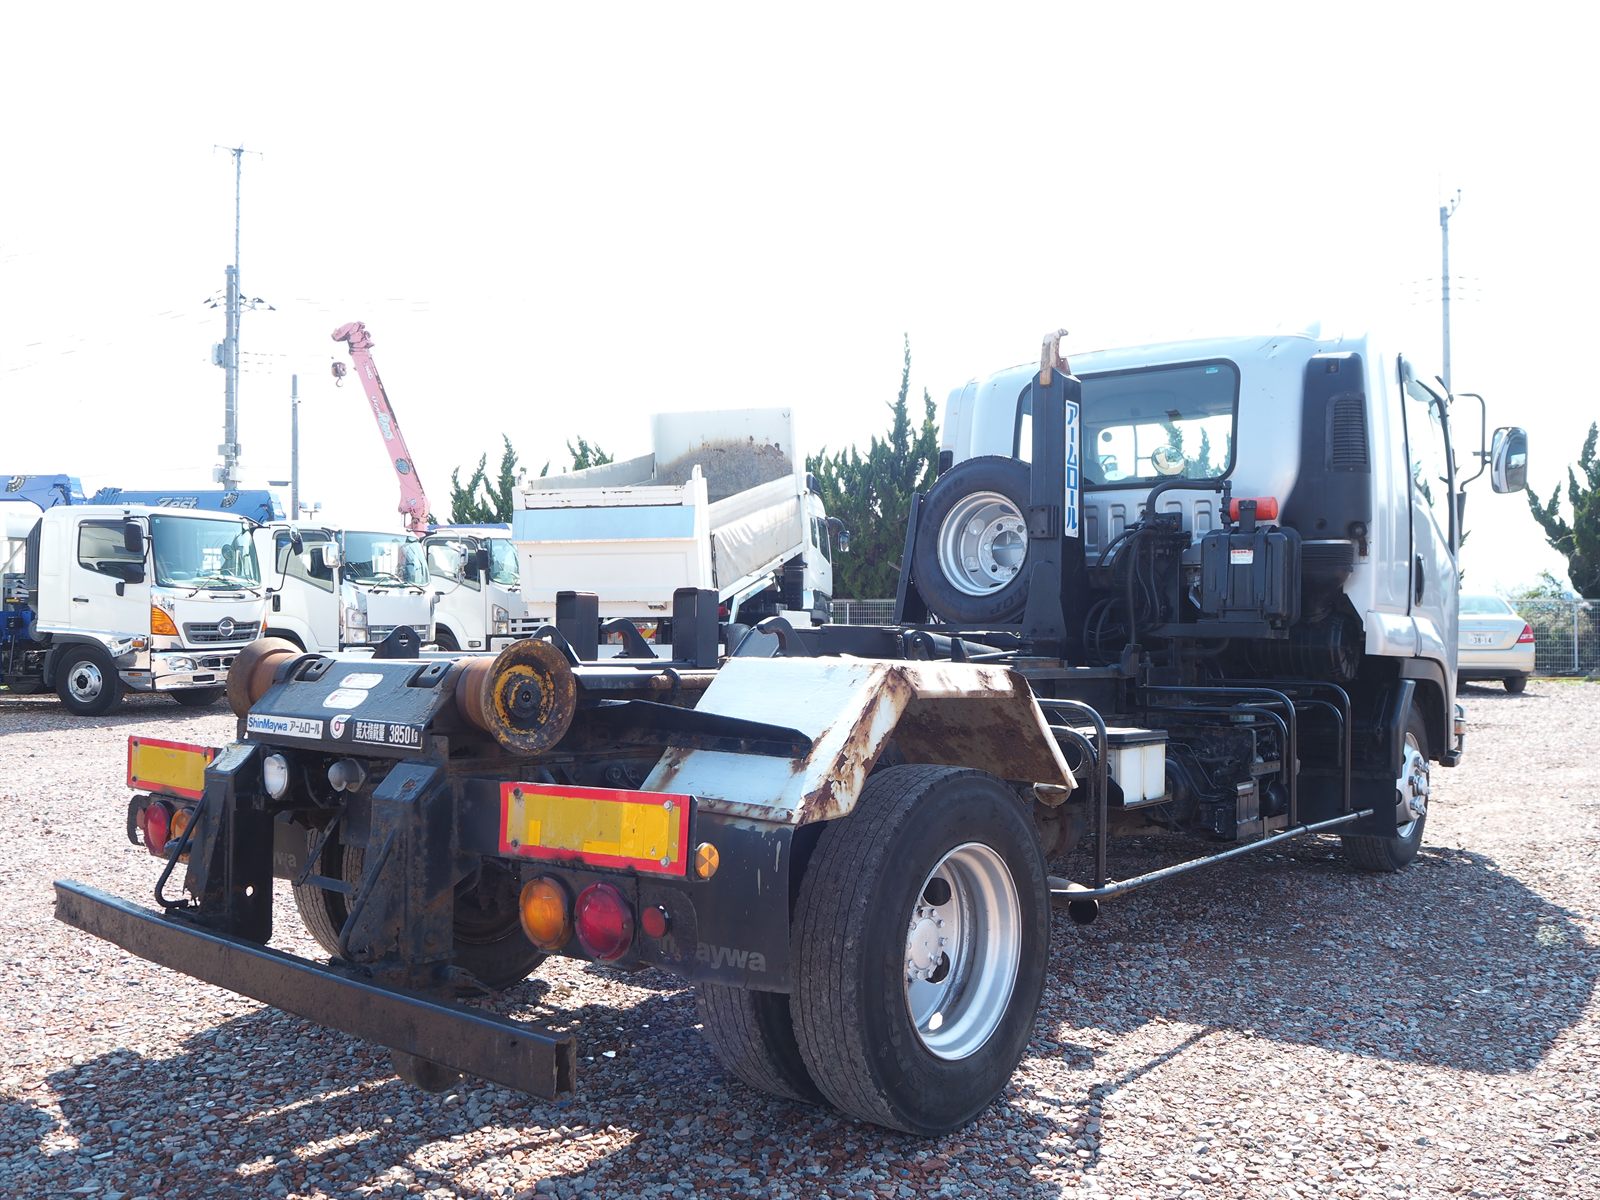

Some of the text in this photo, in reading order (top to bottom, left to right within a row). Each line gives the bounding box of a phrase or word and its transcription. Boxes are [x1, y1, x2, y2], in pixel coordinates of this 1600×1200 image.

[1066, 402, 1079, 530] アームロール
[248, 716, 321, 735] ShinMaywa アームロール
[355, 721, 386, 742] 最大積載量
